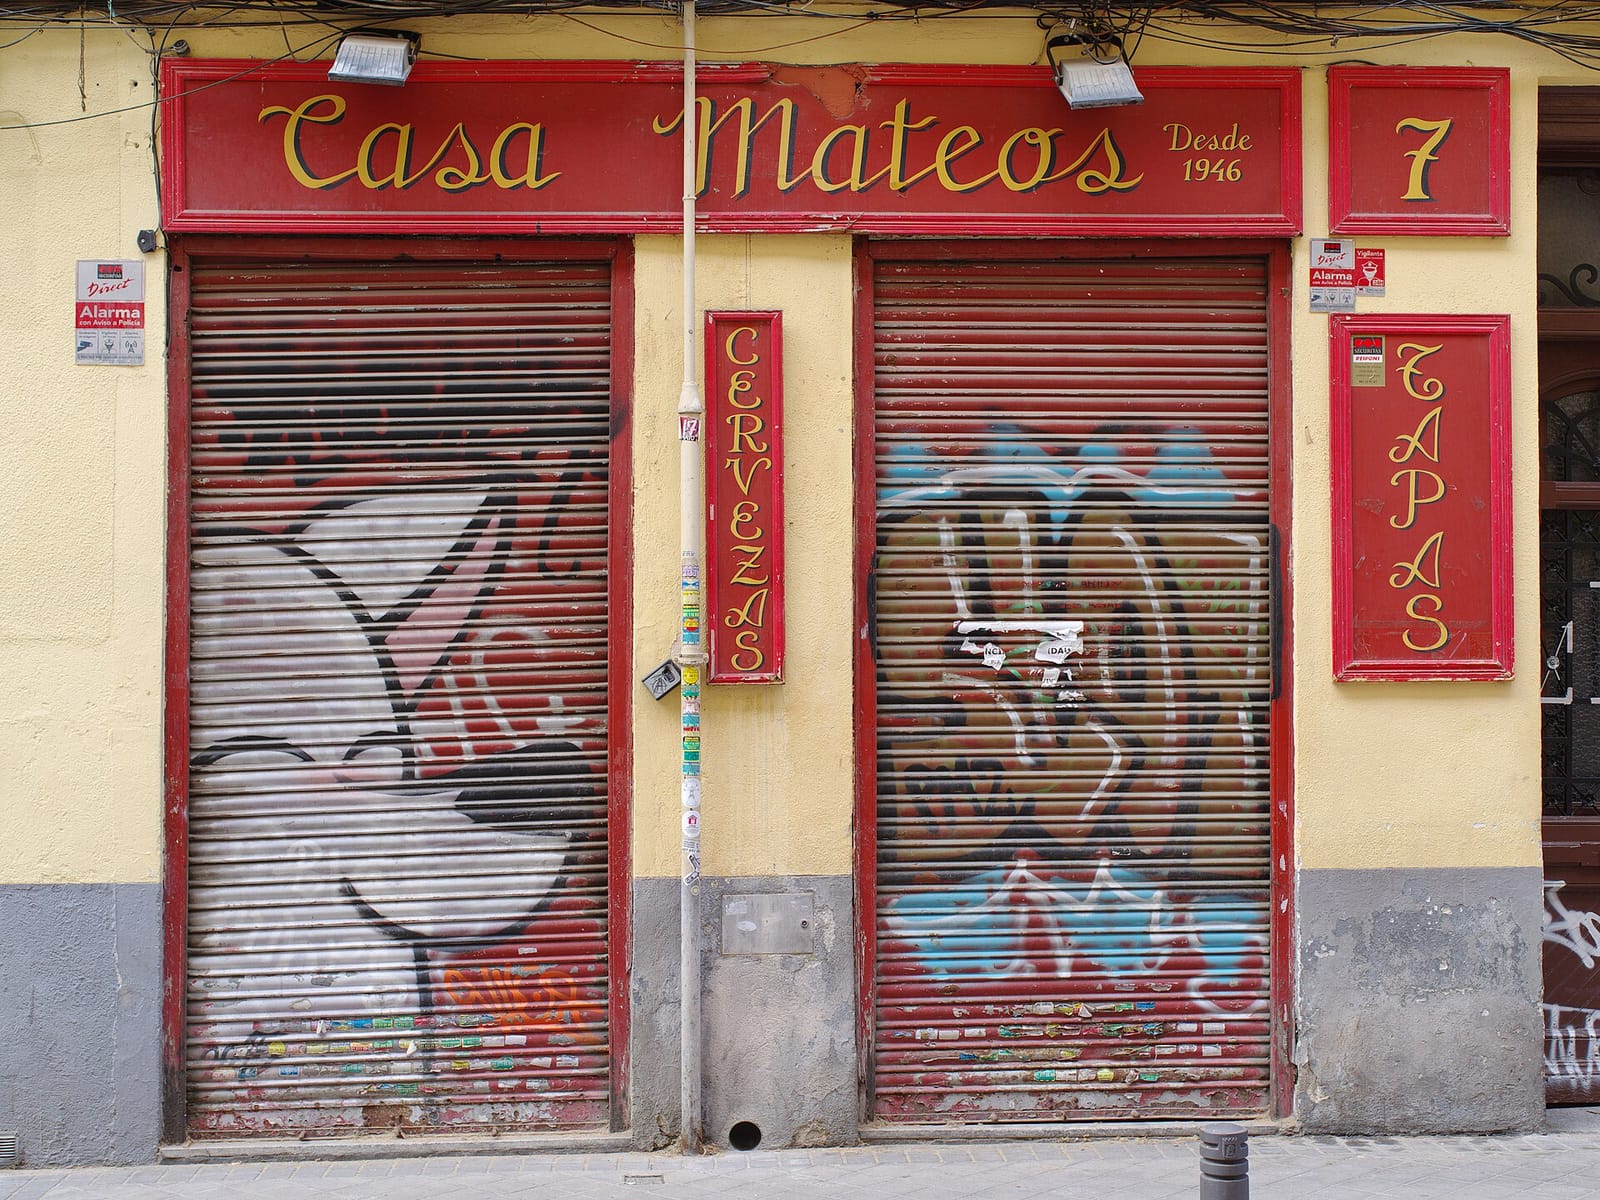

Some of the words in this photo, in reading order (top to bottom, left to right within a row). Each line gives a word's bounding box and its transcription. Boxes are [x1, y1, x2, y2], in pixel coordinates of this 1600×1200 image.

[258, 94, 563, 193] Casa
[653, 96, 1145, 198] Mateos
[1163, 122, 1253, 152] Desde
[1183, 158, 1242, 182] 1946
[1396, 117, 1454, 201] 7
[1316, 252, 1347, 265] Direct
[87, 277, 135, 298] Direct
[1312, 270, 1353, 281] Alarma
[80, 305, 140, 319] Alarma
[724, 326, 773, 673] CERVEZAS
[1388, 343, 1450, 652] TAPAS
